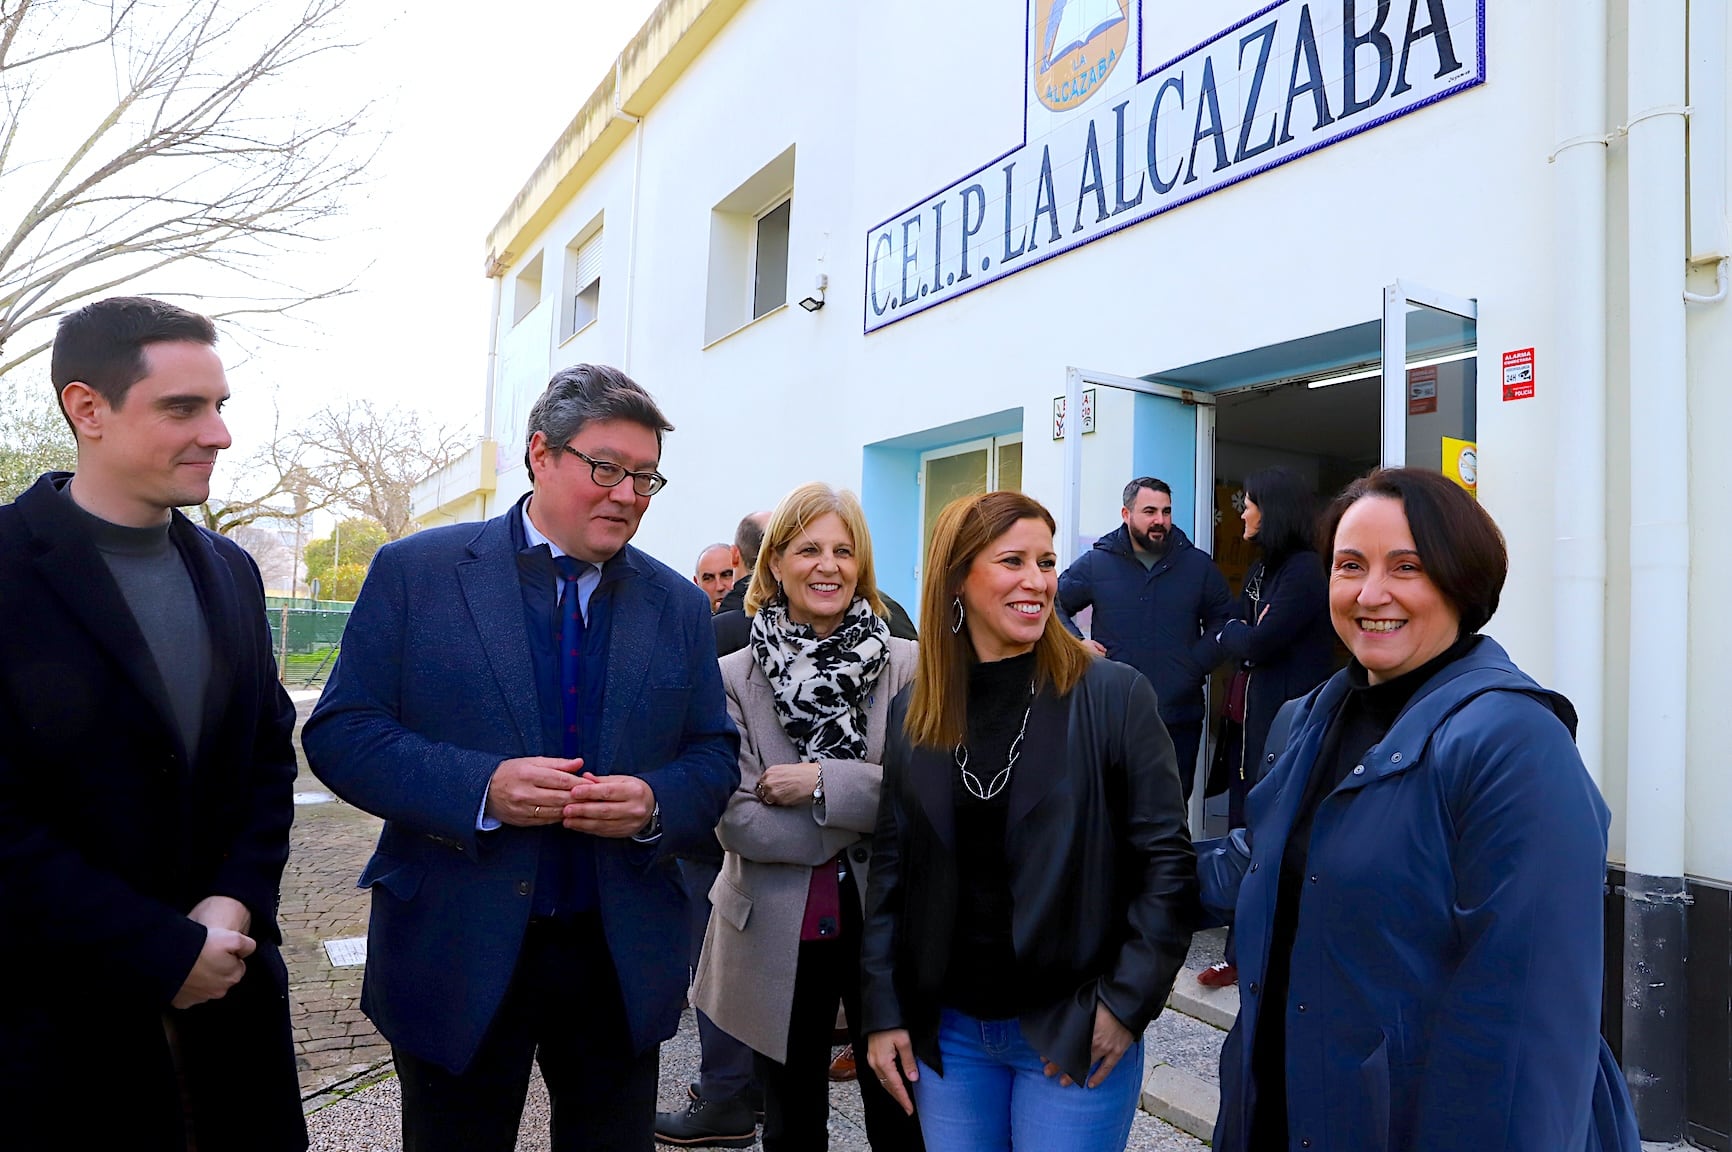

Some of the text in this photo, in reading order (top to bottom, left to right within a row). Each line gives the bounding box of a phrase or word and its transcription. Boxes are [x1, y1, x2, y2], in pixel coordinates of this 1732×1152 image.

[1046, 48, 1116, 102] ALCAZABA
[1073, 54, 1087, 71] LA
[871, 0, 1463, 316] C.E.I.P. LA ALCAZABA
[1505, 351, 1531, 361] ALARMA
